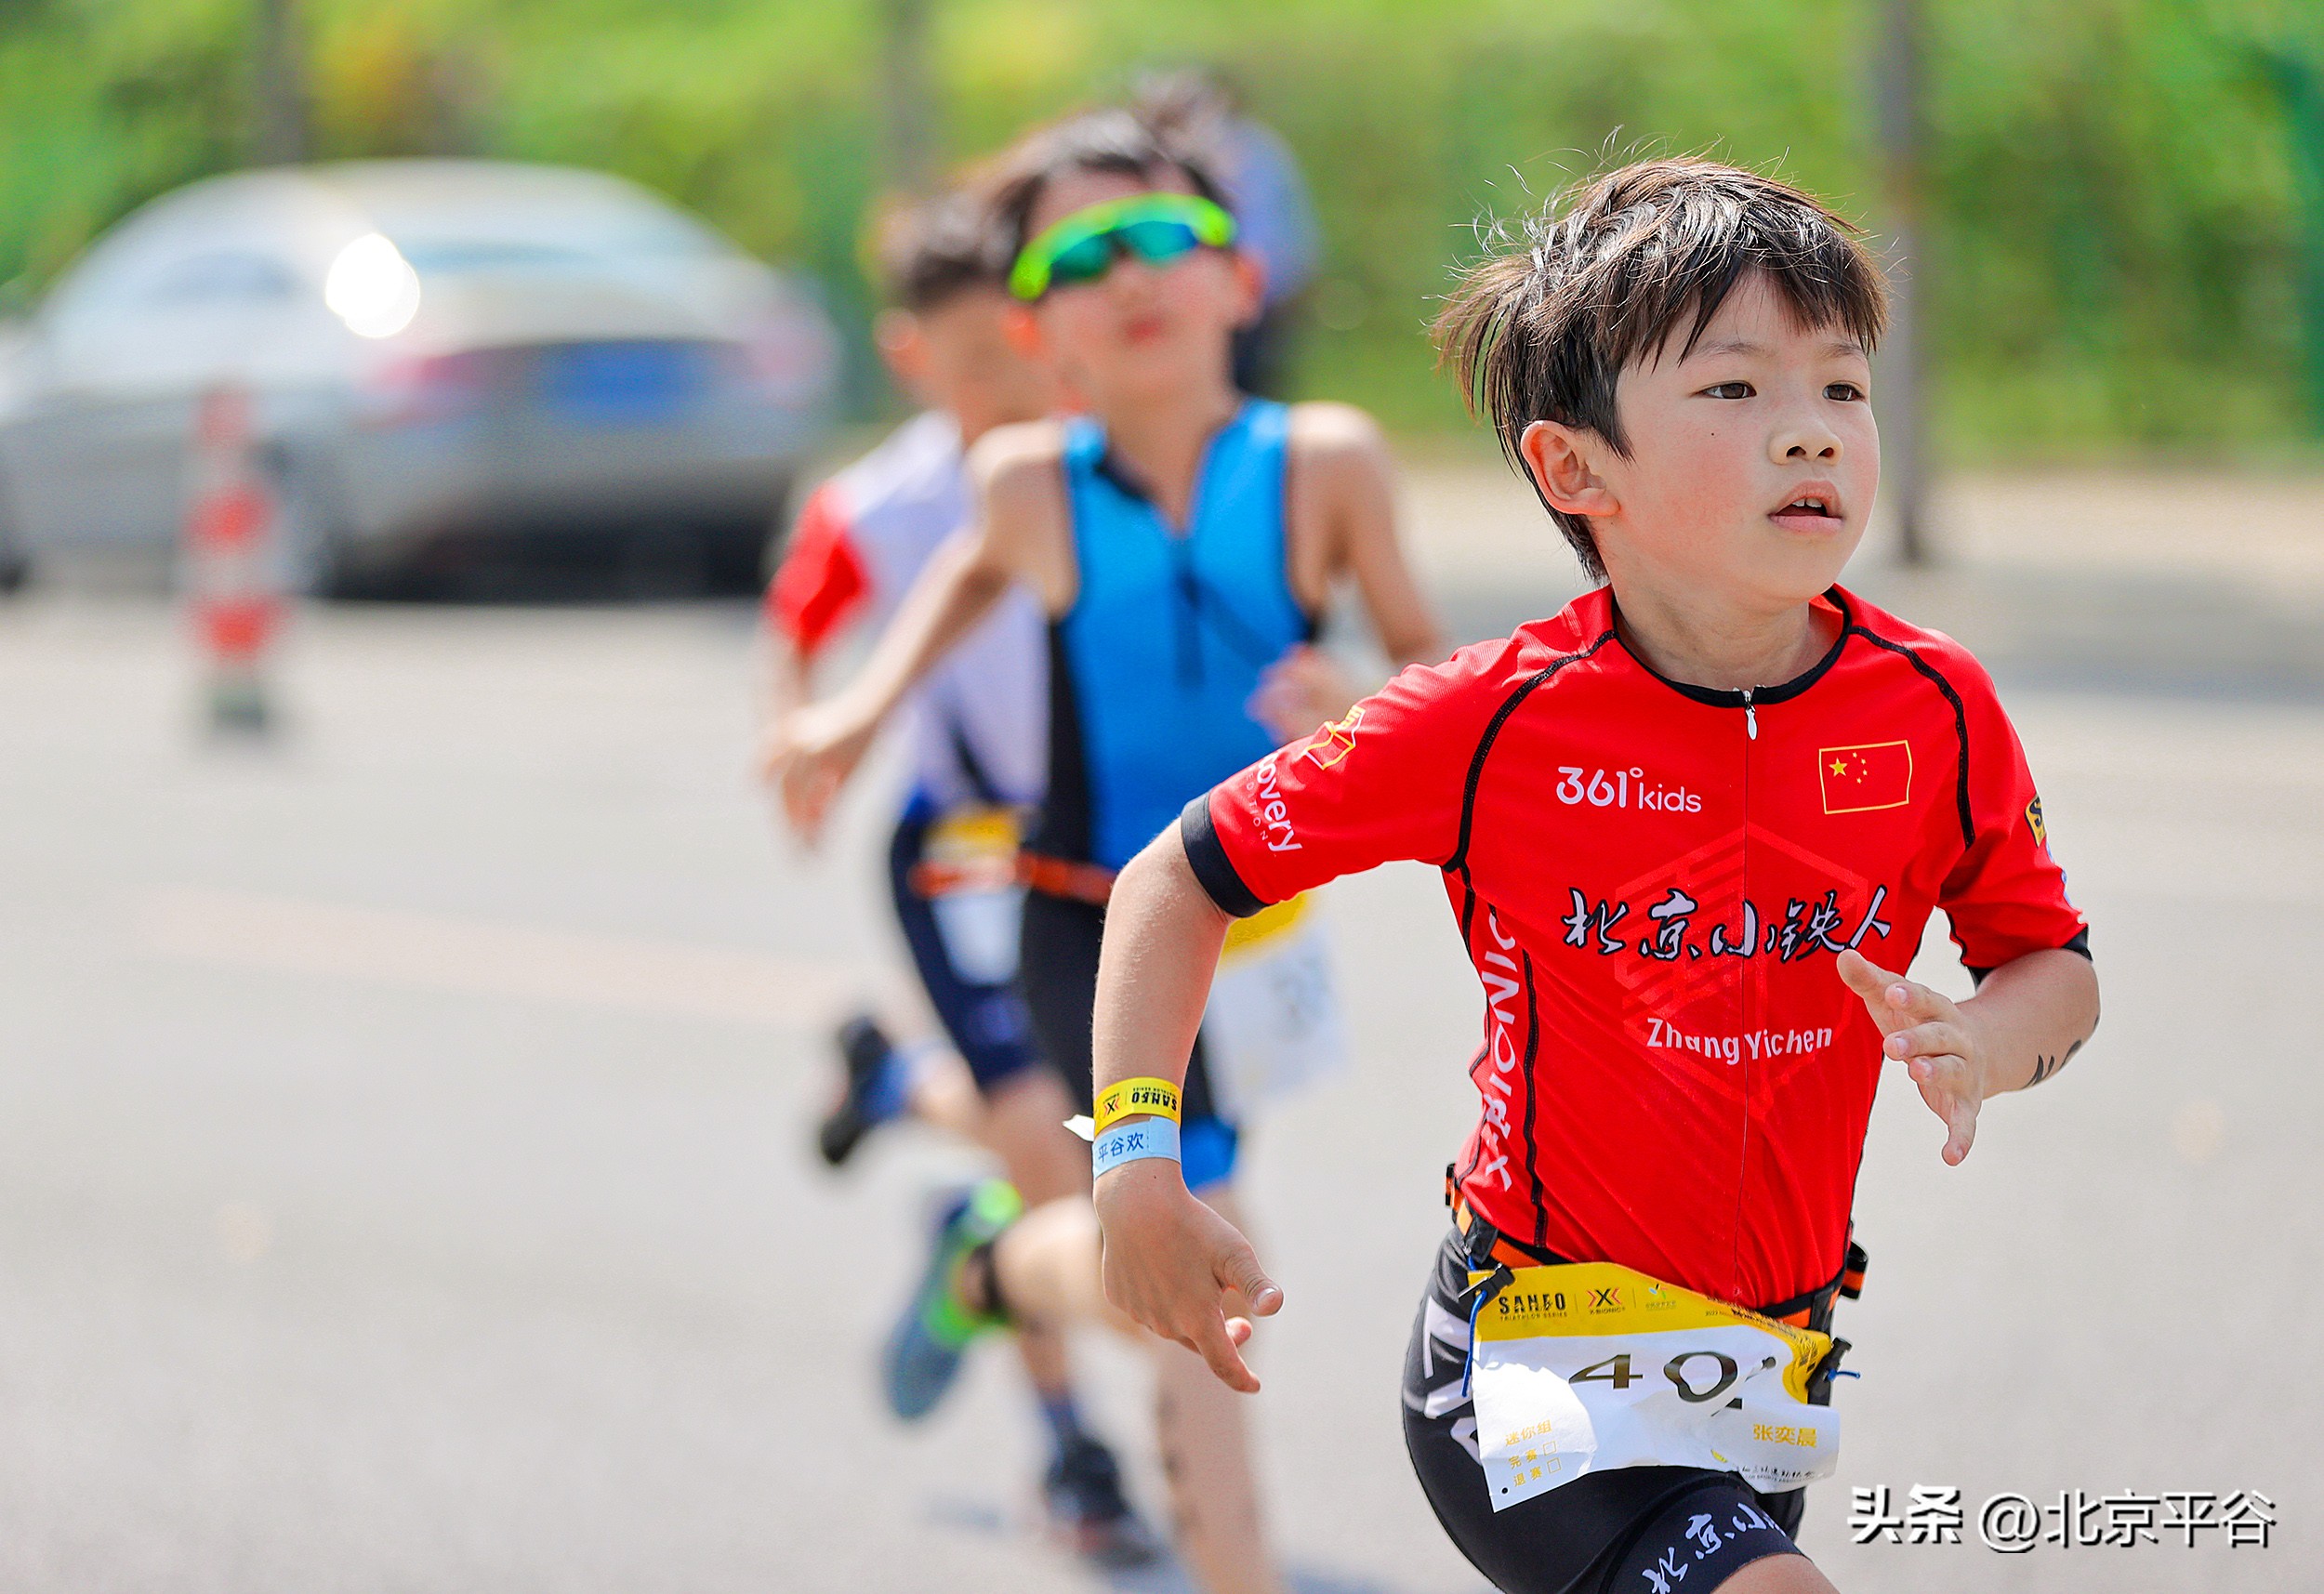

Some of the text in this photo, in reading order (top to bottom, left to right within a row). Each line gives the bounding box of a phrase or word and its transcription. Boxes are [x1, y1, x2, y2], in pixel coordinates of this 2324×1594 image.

[1561, 885, 1893, 965] 北京小铁人
[1646, 1017, 1833, 1066] Zhang Yichen
[1097, 1132, 1144, 1163] 平谷欢
[1499, 1292, 1566, 1315] SANFO
[1505, 1419, 1552, 1446] 迷你组
[1752, 1423, 1817, 1449] 张奕晨
